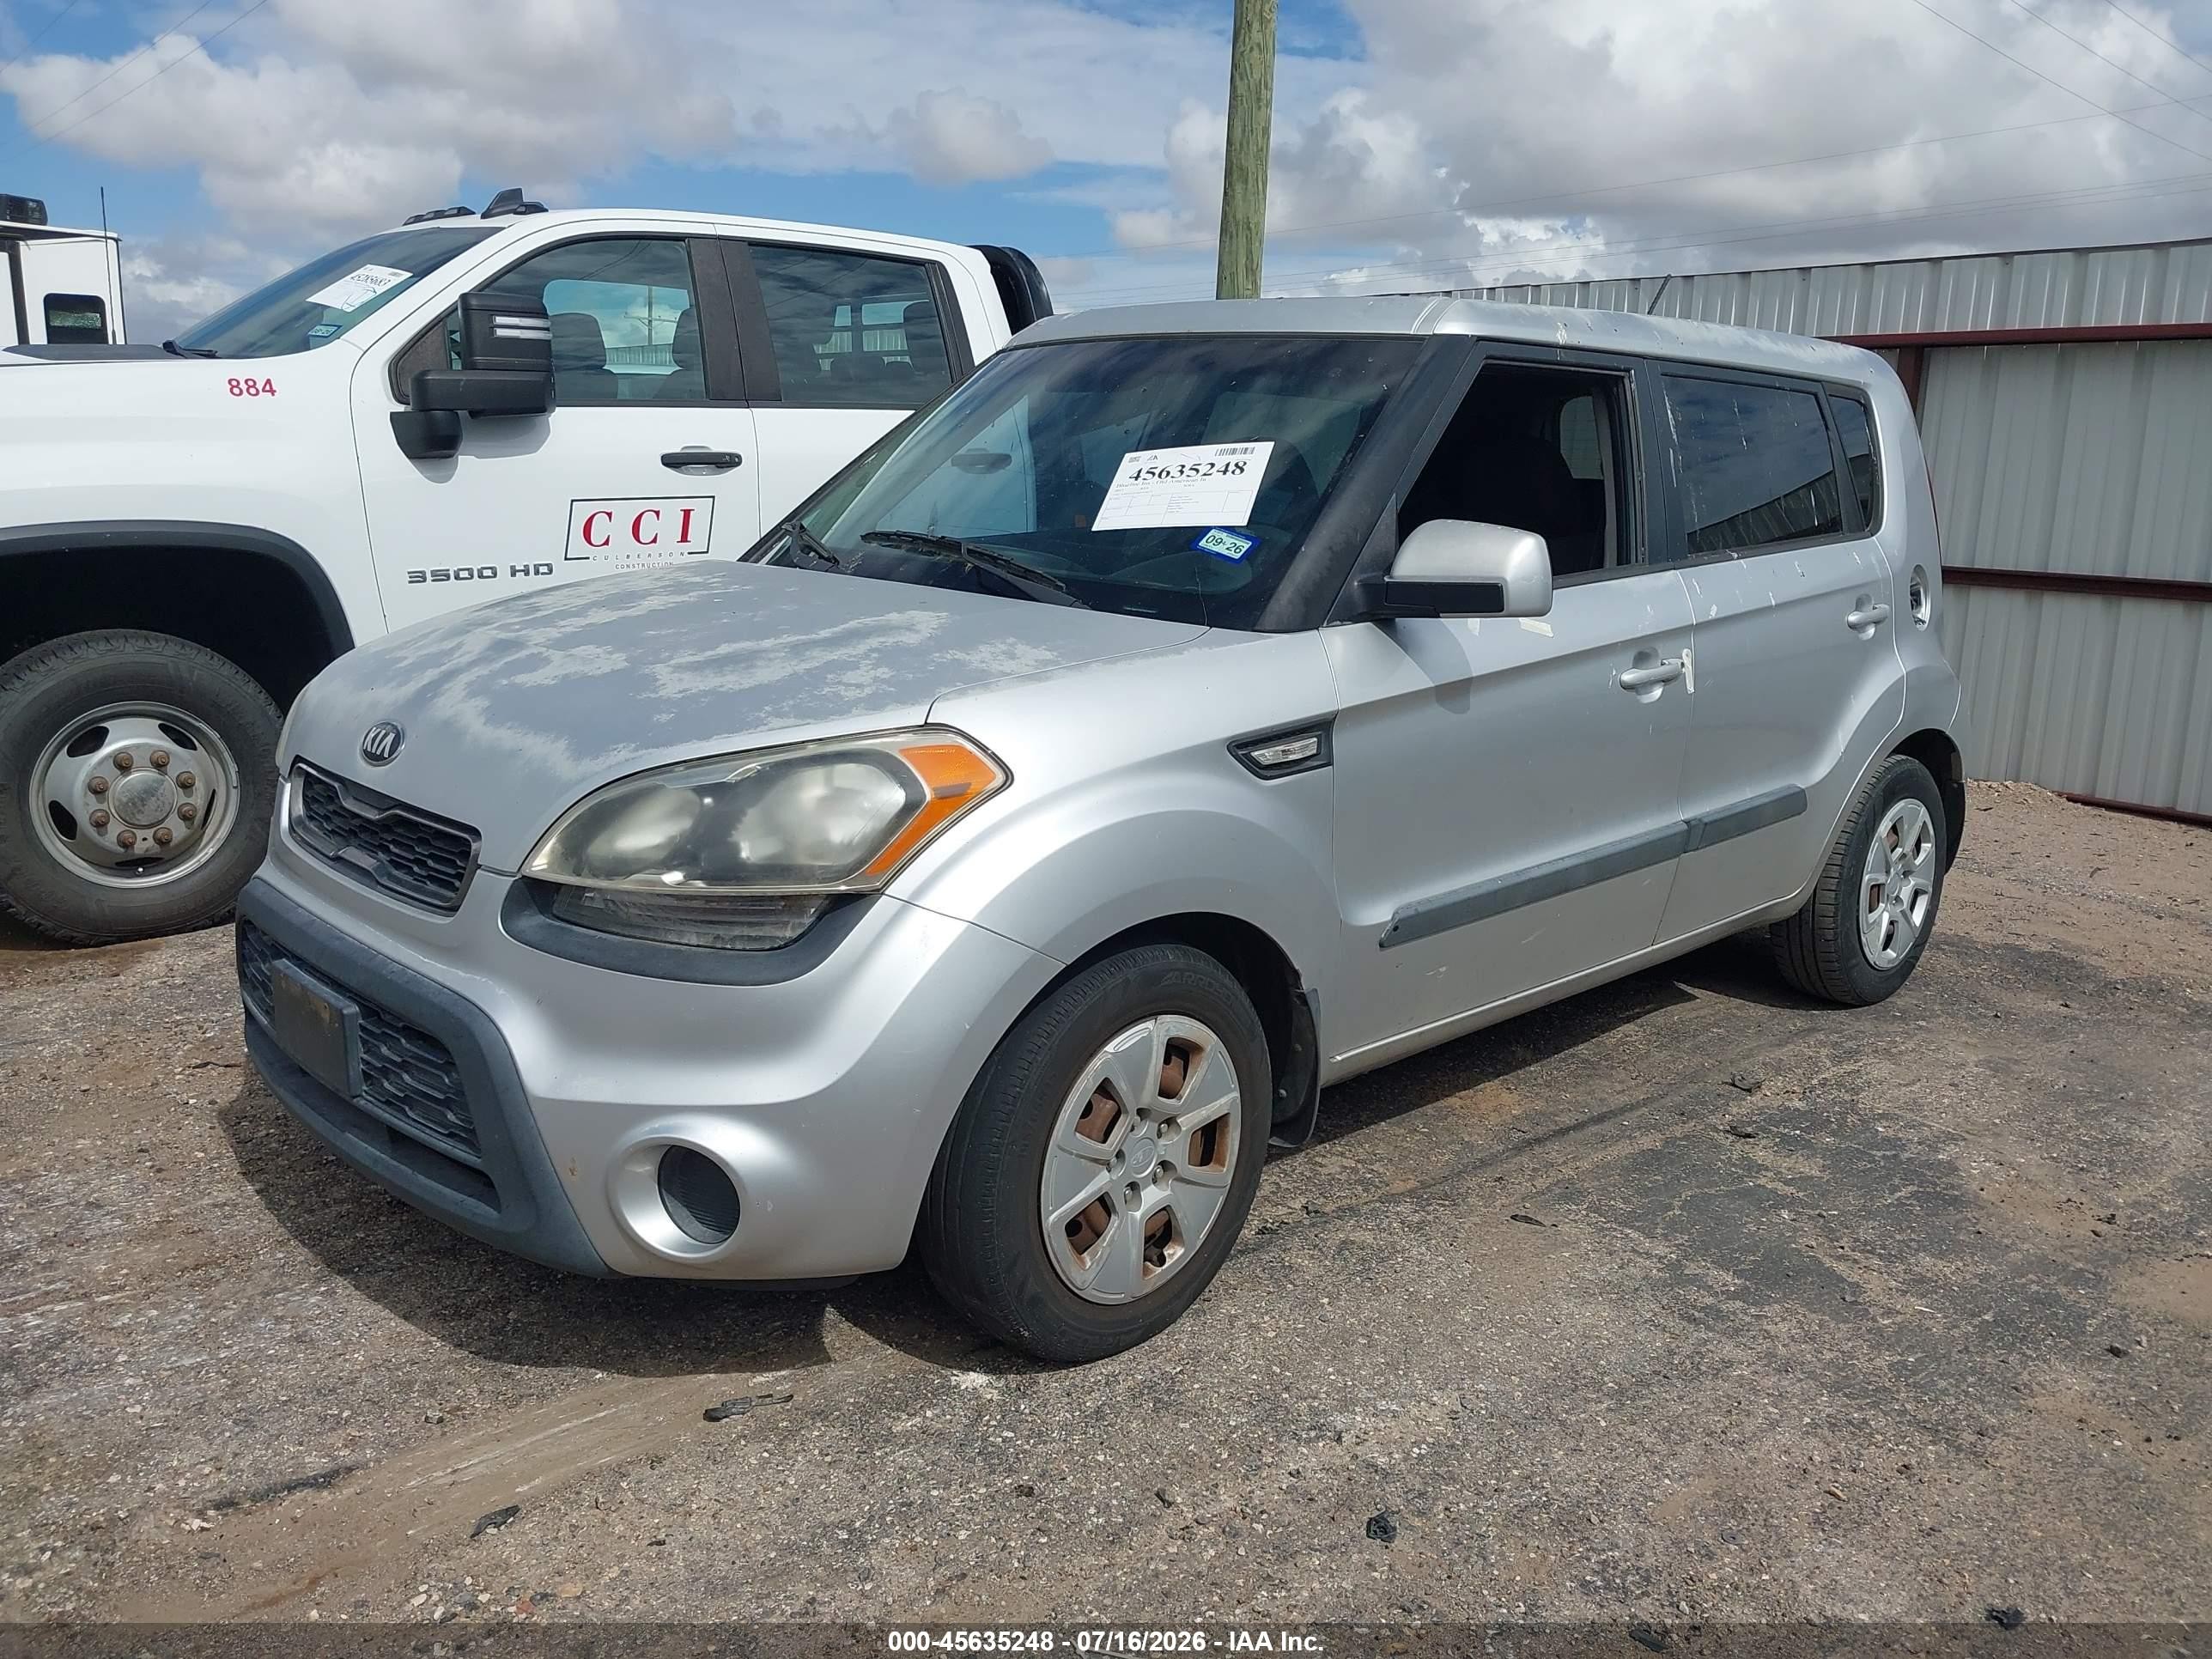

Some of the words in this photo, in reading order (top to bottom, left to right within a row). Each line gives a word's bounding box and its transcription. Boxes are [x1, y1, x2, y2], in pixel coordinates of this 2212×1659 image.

[228, 378, 276, 397] 884
[1128, 460, 1248, 482] 45635248
[582, 508, 696, 548] CCI
[1205, 534, 1224, 546] 09
[1225, 542, 1245, 554] 26
[593, 551, 685, 561] CULBERSON
[407, 566, 498, 584] 3500
[509, 562, 554, 578] HD
[363, 726, 396, 758] KIA
